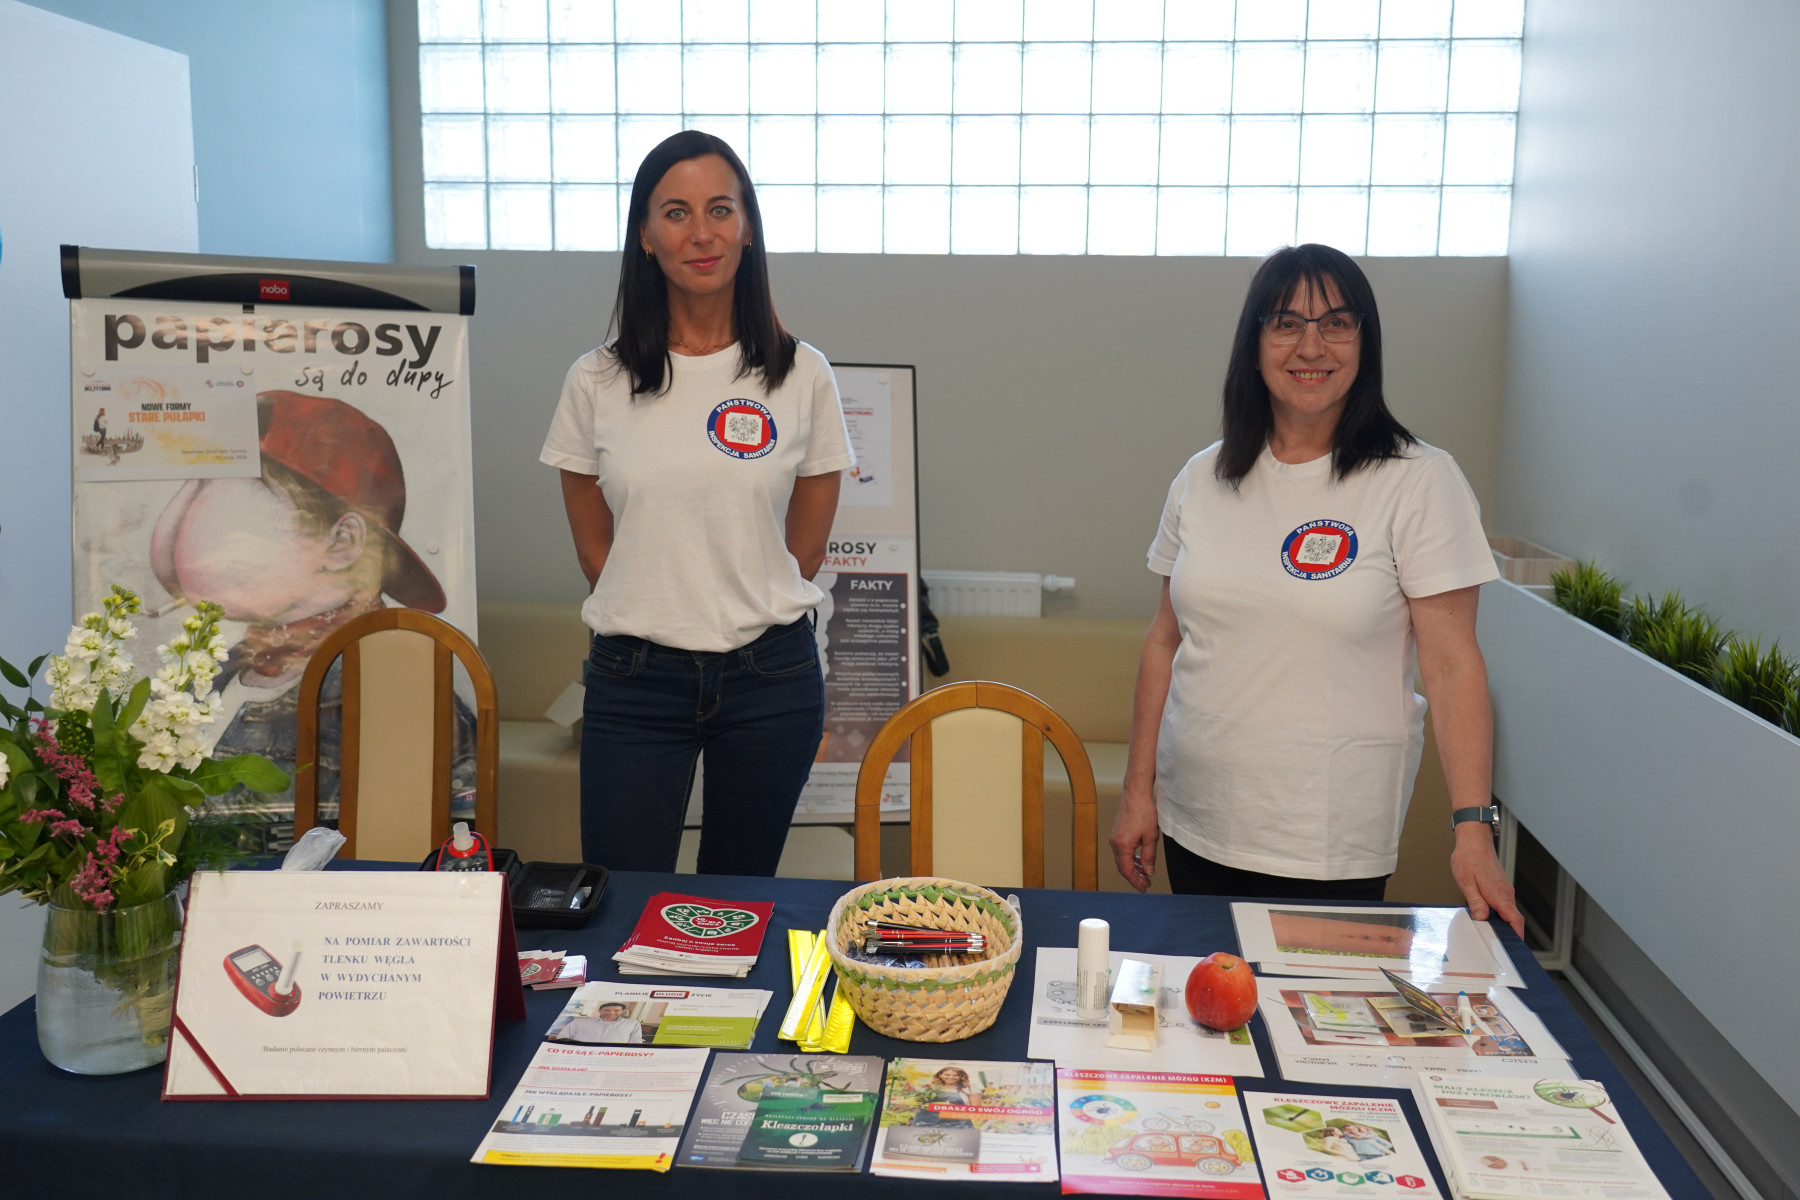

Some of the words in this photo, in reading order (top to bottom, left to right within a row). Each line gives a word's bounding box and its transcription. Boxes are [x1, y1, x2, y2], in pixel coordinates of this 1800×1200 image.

[261, 284, 287, 295] nobo
[104, 304, 442, 369] papierosy
[295, 366, 324, 391] są
[341, 360, 367, 386] do
[386, 358, 453, 398] dupy
[141, 403, 164, 411] NOWE
[165, 402, 191, 411] FORMY
[716, 400, 771, 420] PAŃSTWOWA
[128, 412, 160, 423] STARE
[163, 411, 205, 423] PUŁAPKI
[709, 430, 740, 457] INSPEKCJA
[743, 439, 776, 458] SANITARNA
[1296, 520, 1354, 537] PAŃSTWOWA
[829, 541, 877, 554] ROSY
[824, 556, 867, 567] FAKTY
[1282, 551, 1307, 579] INSPEKCJA
[1311, 557, 1353, 579] SANITARNA
[850, 580, 893, 591] FAKTY
[315, 902, 384, 910] ZAPRASZAMY
[324, 937, 340, 946] NA
[345, 937, 391, 947] POMIAR
[396, 935, 472, 947] ZAWARTOŚCI
[322, 955, 368, 965] TLENKU
[373, 955, 415, 967] WĘGLA
[320, 973, 331, 982] W
[336, 973, 422, 983] WYDYCHANYM
[318, 991, 387, 1001] POWIETRZU
[289, 1046, 317, 1054] polecane
[350, 1046, 376, 1054] biernym
[588, 1050, 654, 1058] E-PAPIEROSY?
[1200, 1076, 1227, 1084] (KZM)
[1466, 1086, 1515, 1094] KLESZCZ
[1274, 1097, 1340, 1105] KLESZCZOWE
[1006, 1107, 1044, 1115] OGRÓD
[760, 1119, 853, 1132] Kleszczołapki
